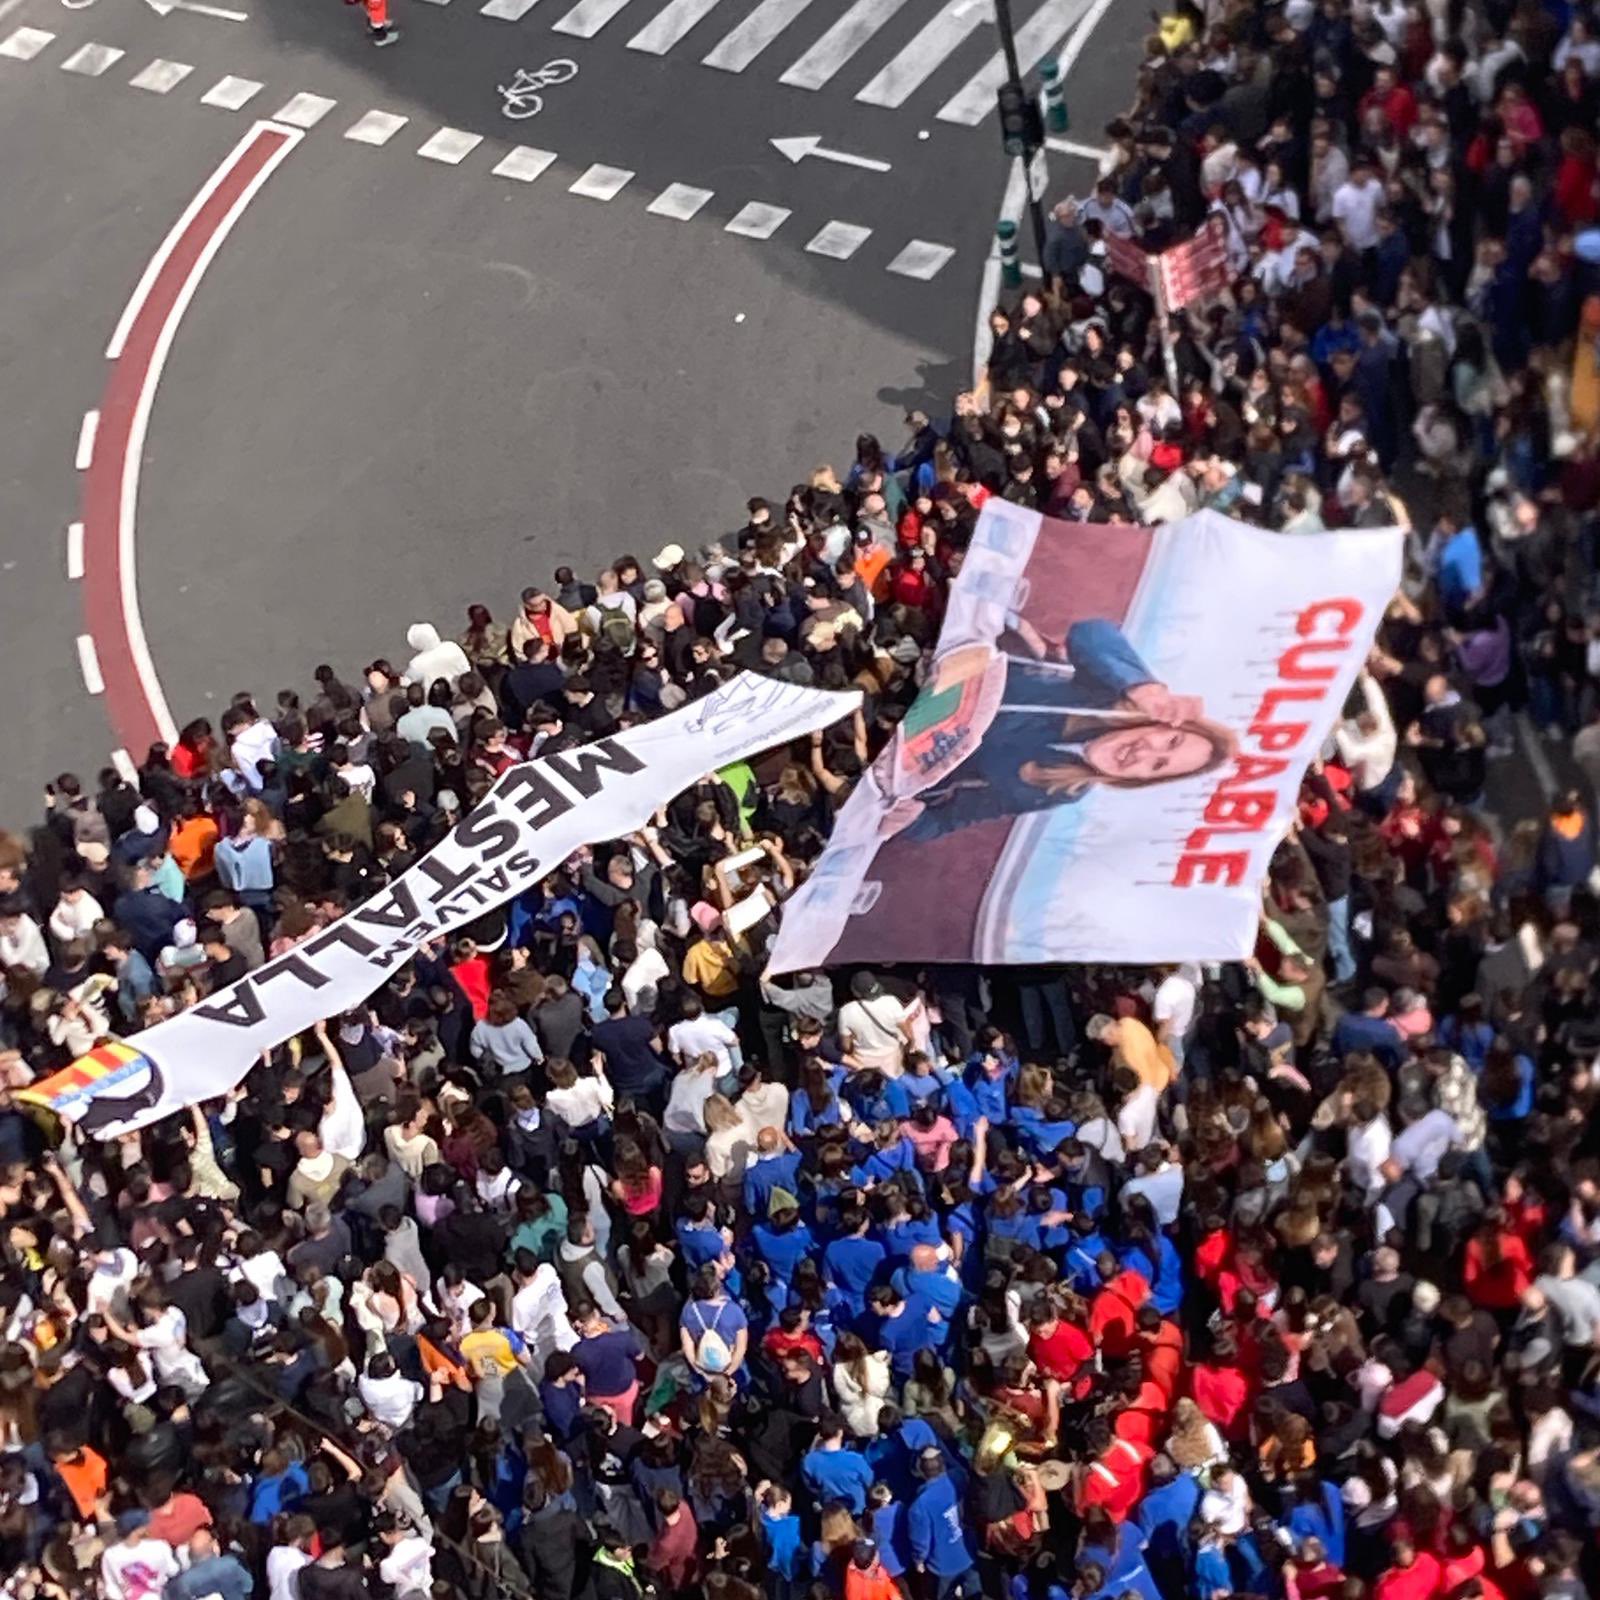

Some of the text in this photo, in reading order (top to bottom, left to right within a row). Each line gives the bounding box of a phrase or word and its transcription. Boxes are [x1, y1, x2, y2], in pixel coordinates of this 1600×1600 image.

[193, 737, 648, 1028] MESTALLA
[1170, 597, 1365, 889] CULPABLE
[368, 849, 541, 968] SALVEM
